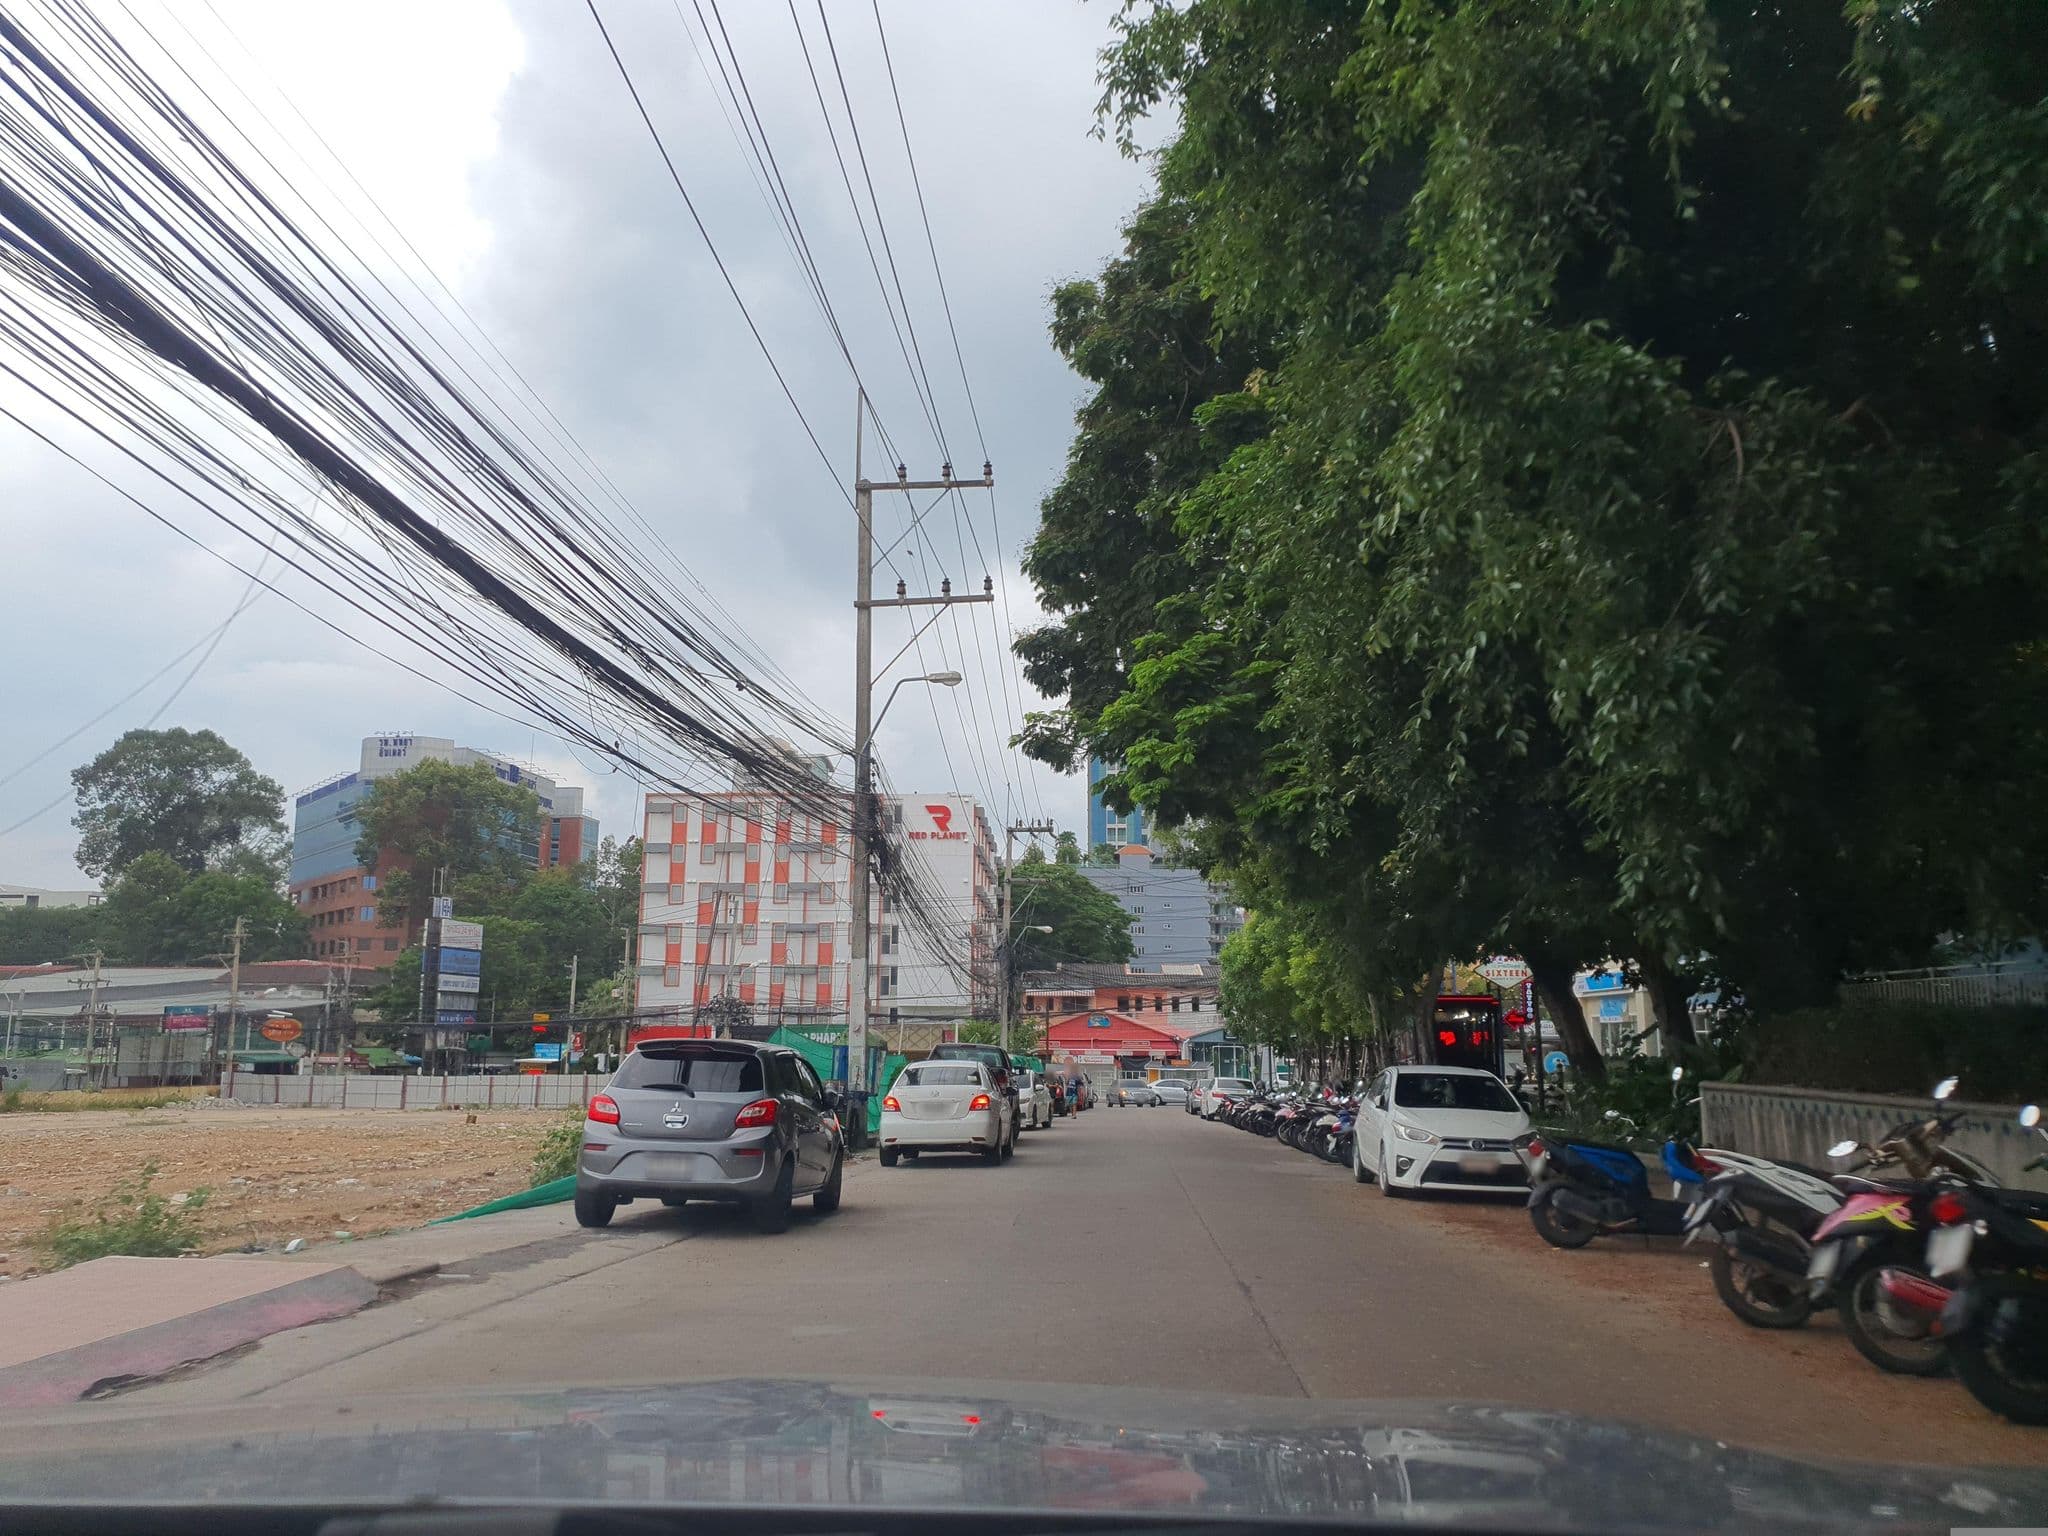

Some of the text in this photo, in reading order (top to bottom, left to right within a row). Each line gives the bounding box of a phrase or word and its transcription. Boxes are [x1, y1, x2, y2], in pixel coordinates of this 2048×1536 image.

[909, 831, 967, 840] RED PLANET
[1485, 969, 1528, 977] SIXTEEN
